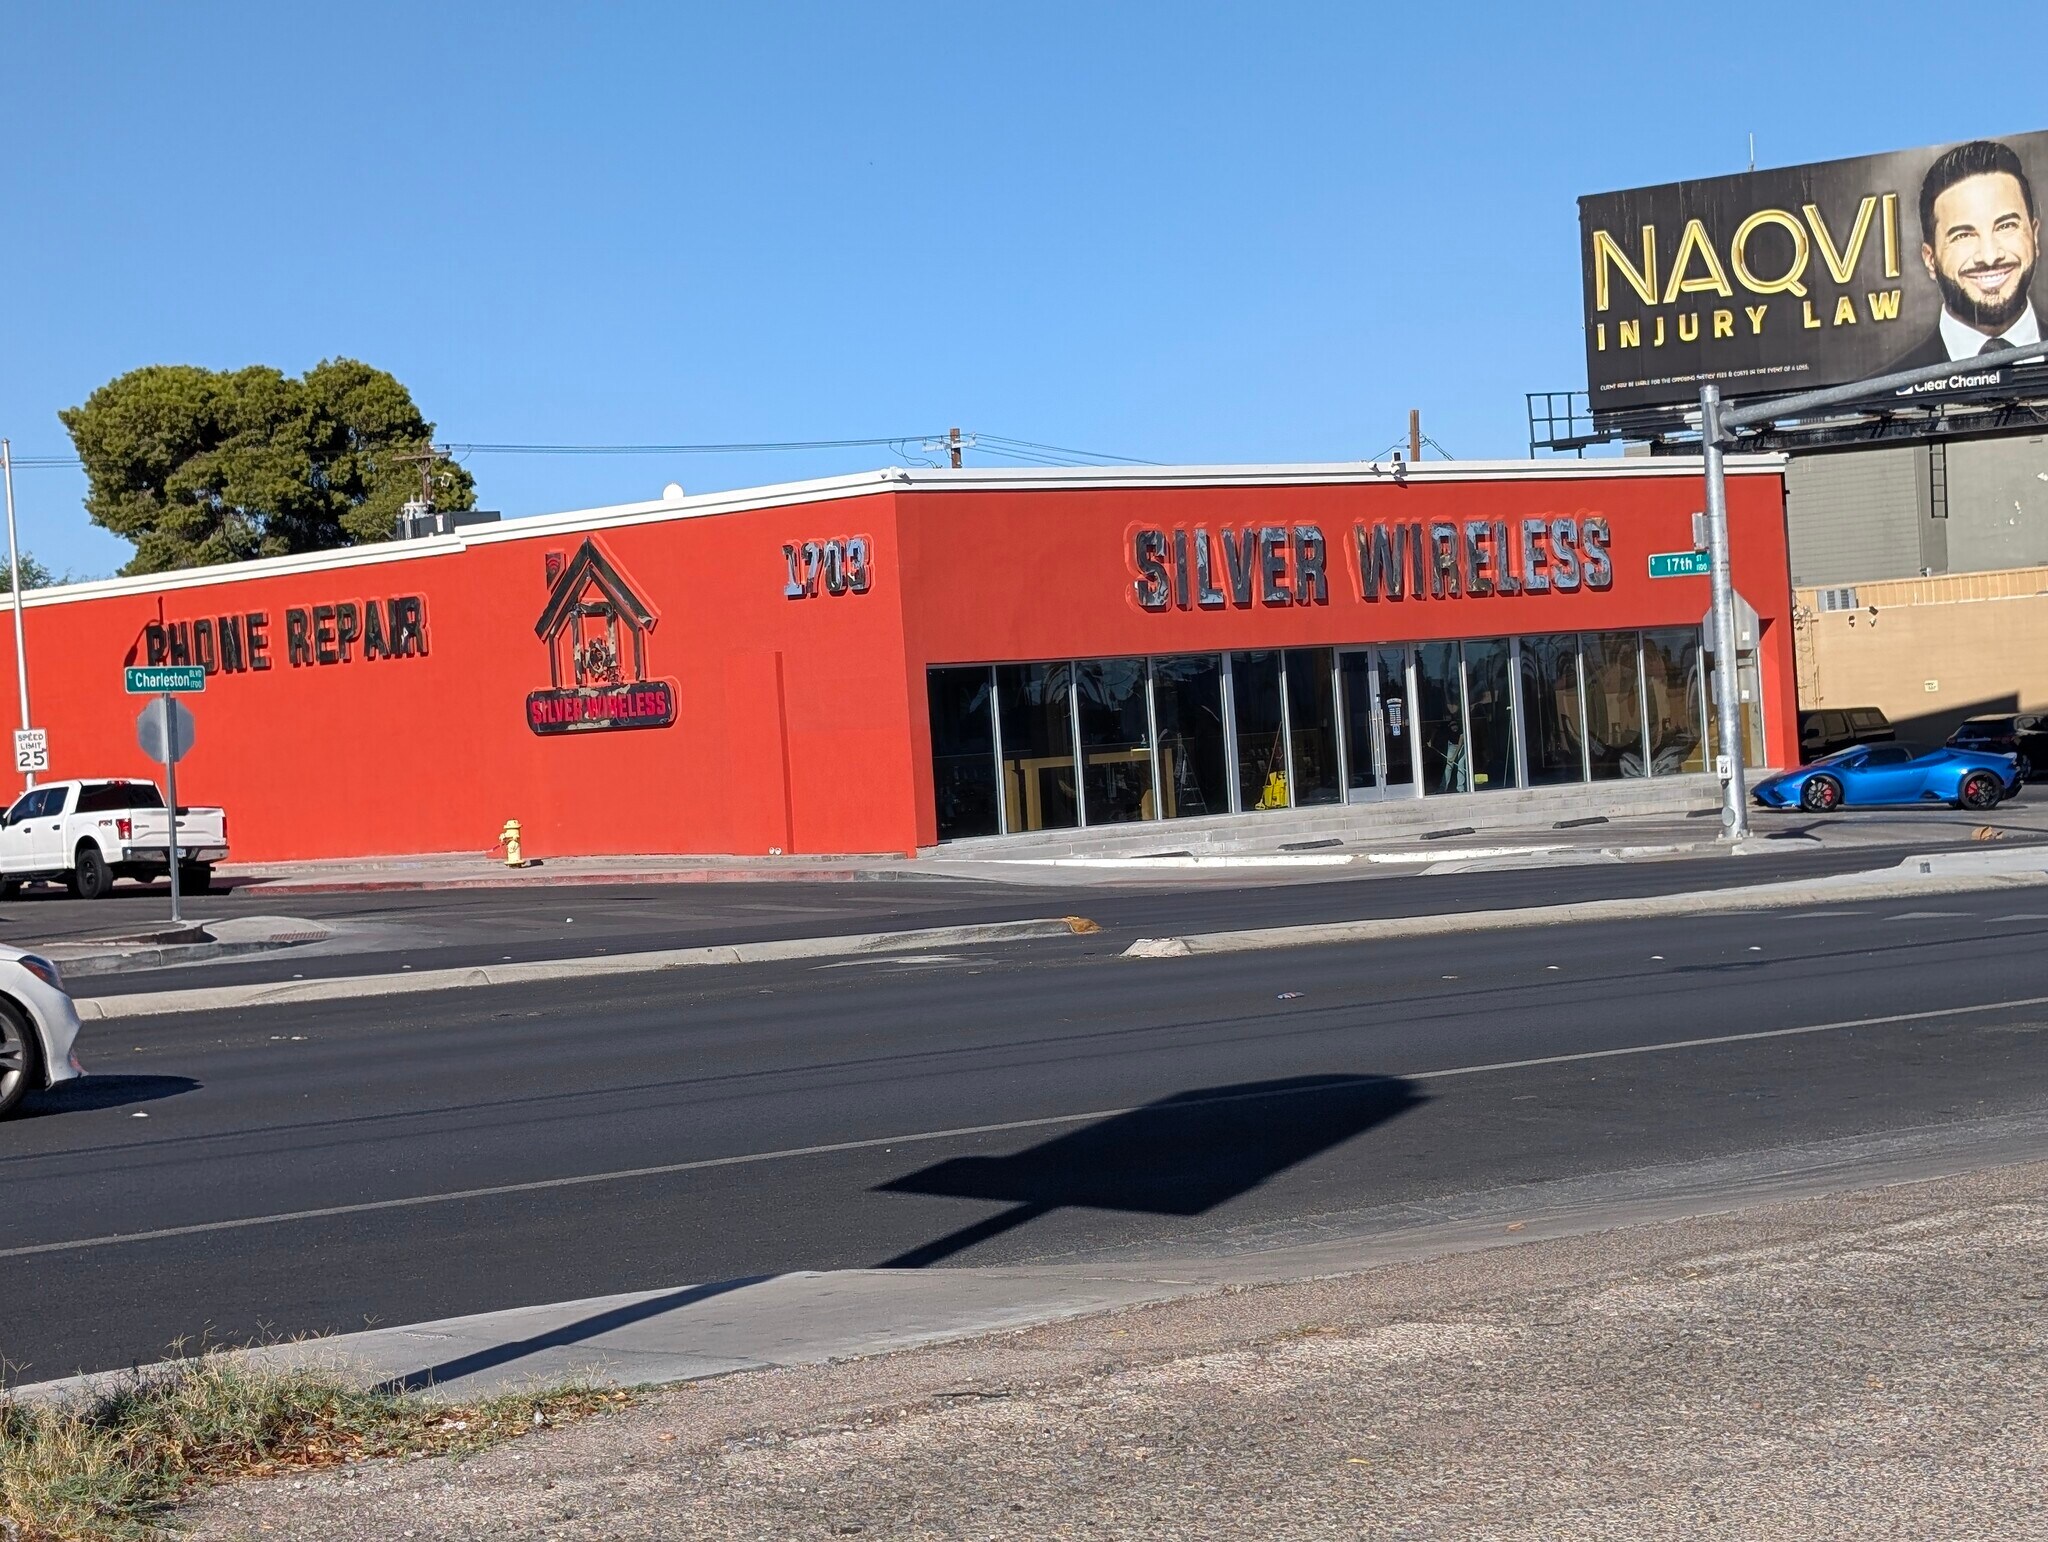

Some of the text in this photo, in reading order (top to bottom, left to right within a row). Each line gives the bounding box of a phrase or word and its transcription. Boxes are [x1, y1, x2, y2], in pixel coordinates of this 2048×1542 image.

[1593, 193, 1900, 311] NAQVI
[1597, 290, 1900, 351] INJURY LAW
[1949, 370, 2000, 389] Channel
[782, 538, 868, 598] 1703
[1134, 516, 1613, 609] SILVER WIRELESS
[1666, 557, 1692, 572] 17th
[146, 595, 428, 674] PHONE REPAIR
[135, 672, 189, 688] Charleston
[531, 691, 667, 724] SILVER WIRELESS
[18, 733, 43, 741] SPEED
[20, 742, 41, 750] LIMIT
[19, 751, 45, 767] 25
